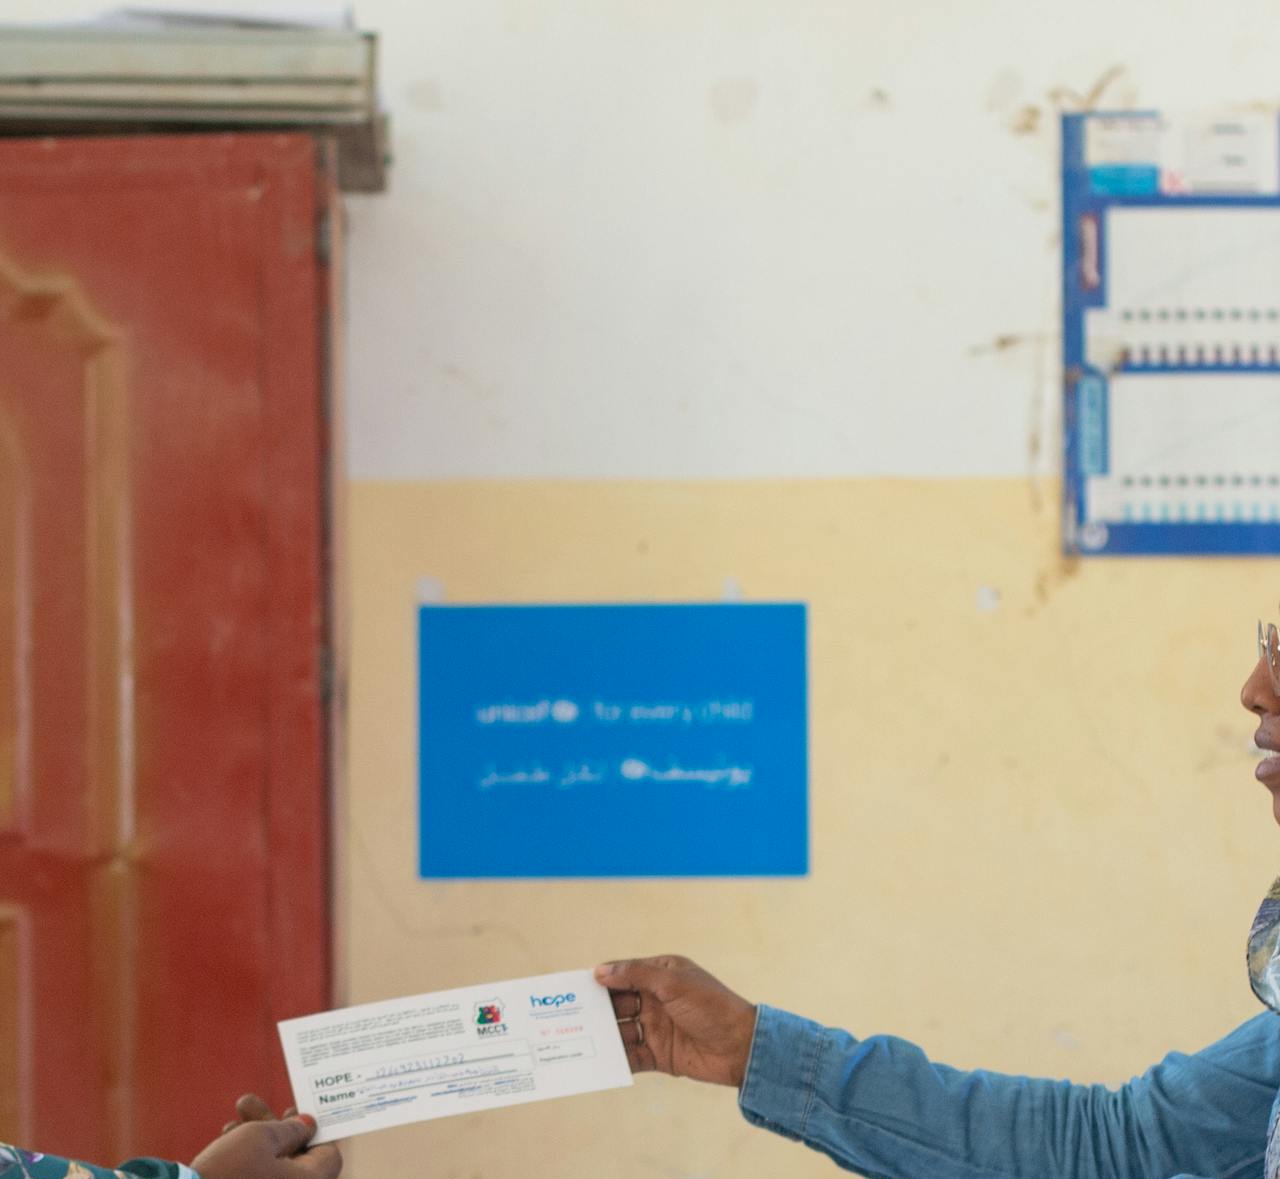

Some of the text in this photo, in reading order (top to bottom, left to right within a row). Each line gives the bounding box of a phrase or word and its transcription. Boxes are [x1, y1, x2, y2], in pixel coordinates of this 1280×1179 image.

[529, 992, 576, 1008] hope
[314, 1072, 353, 1089] HOPE
[318, 1088, 356, 1105] Name
